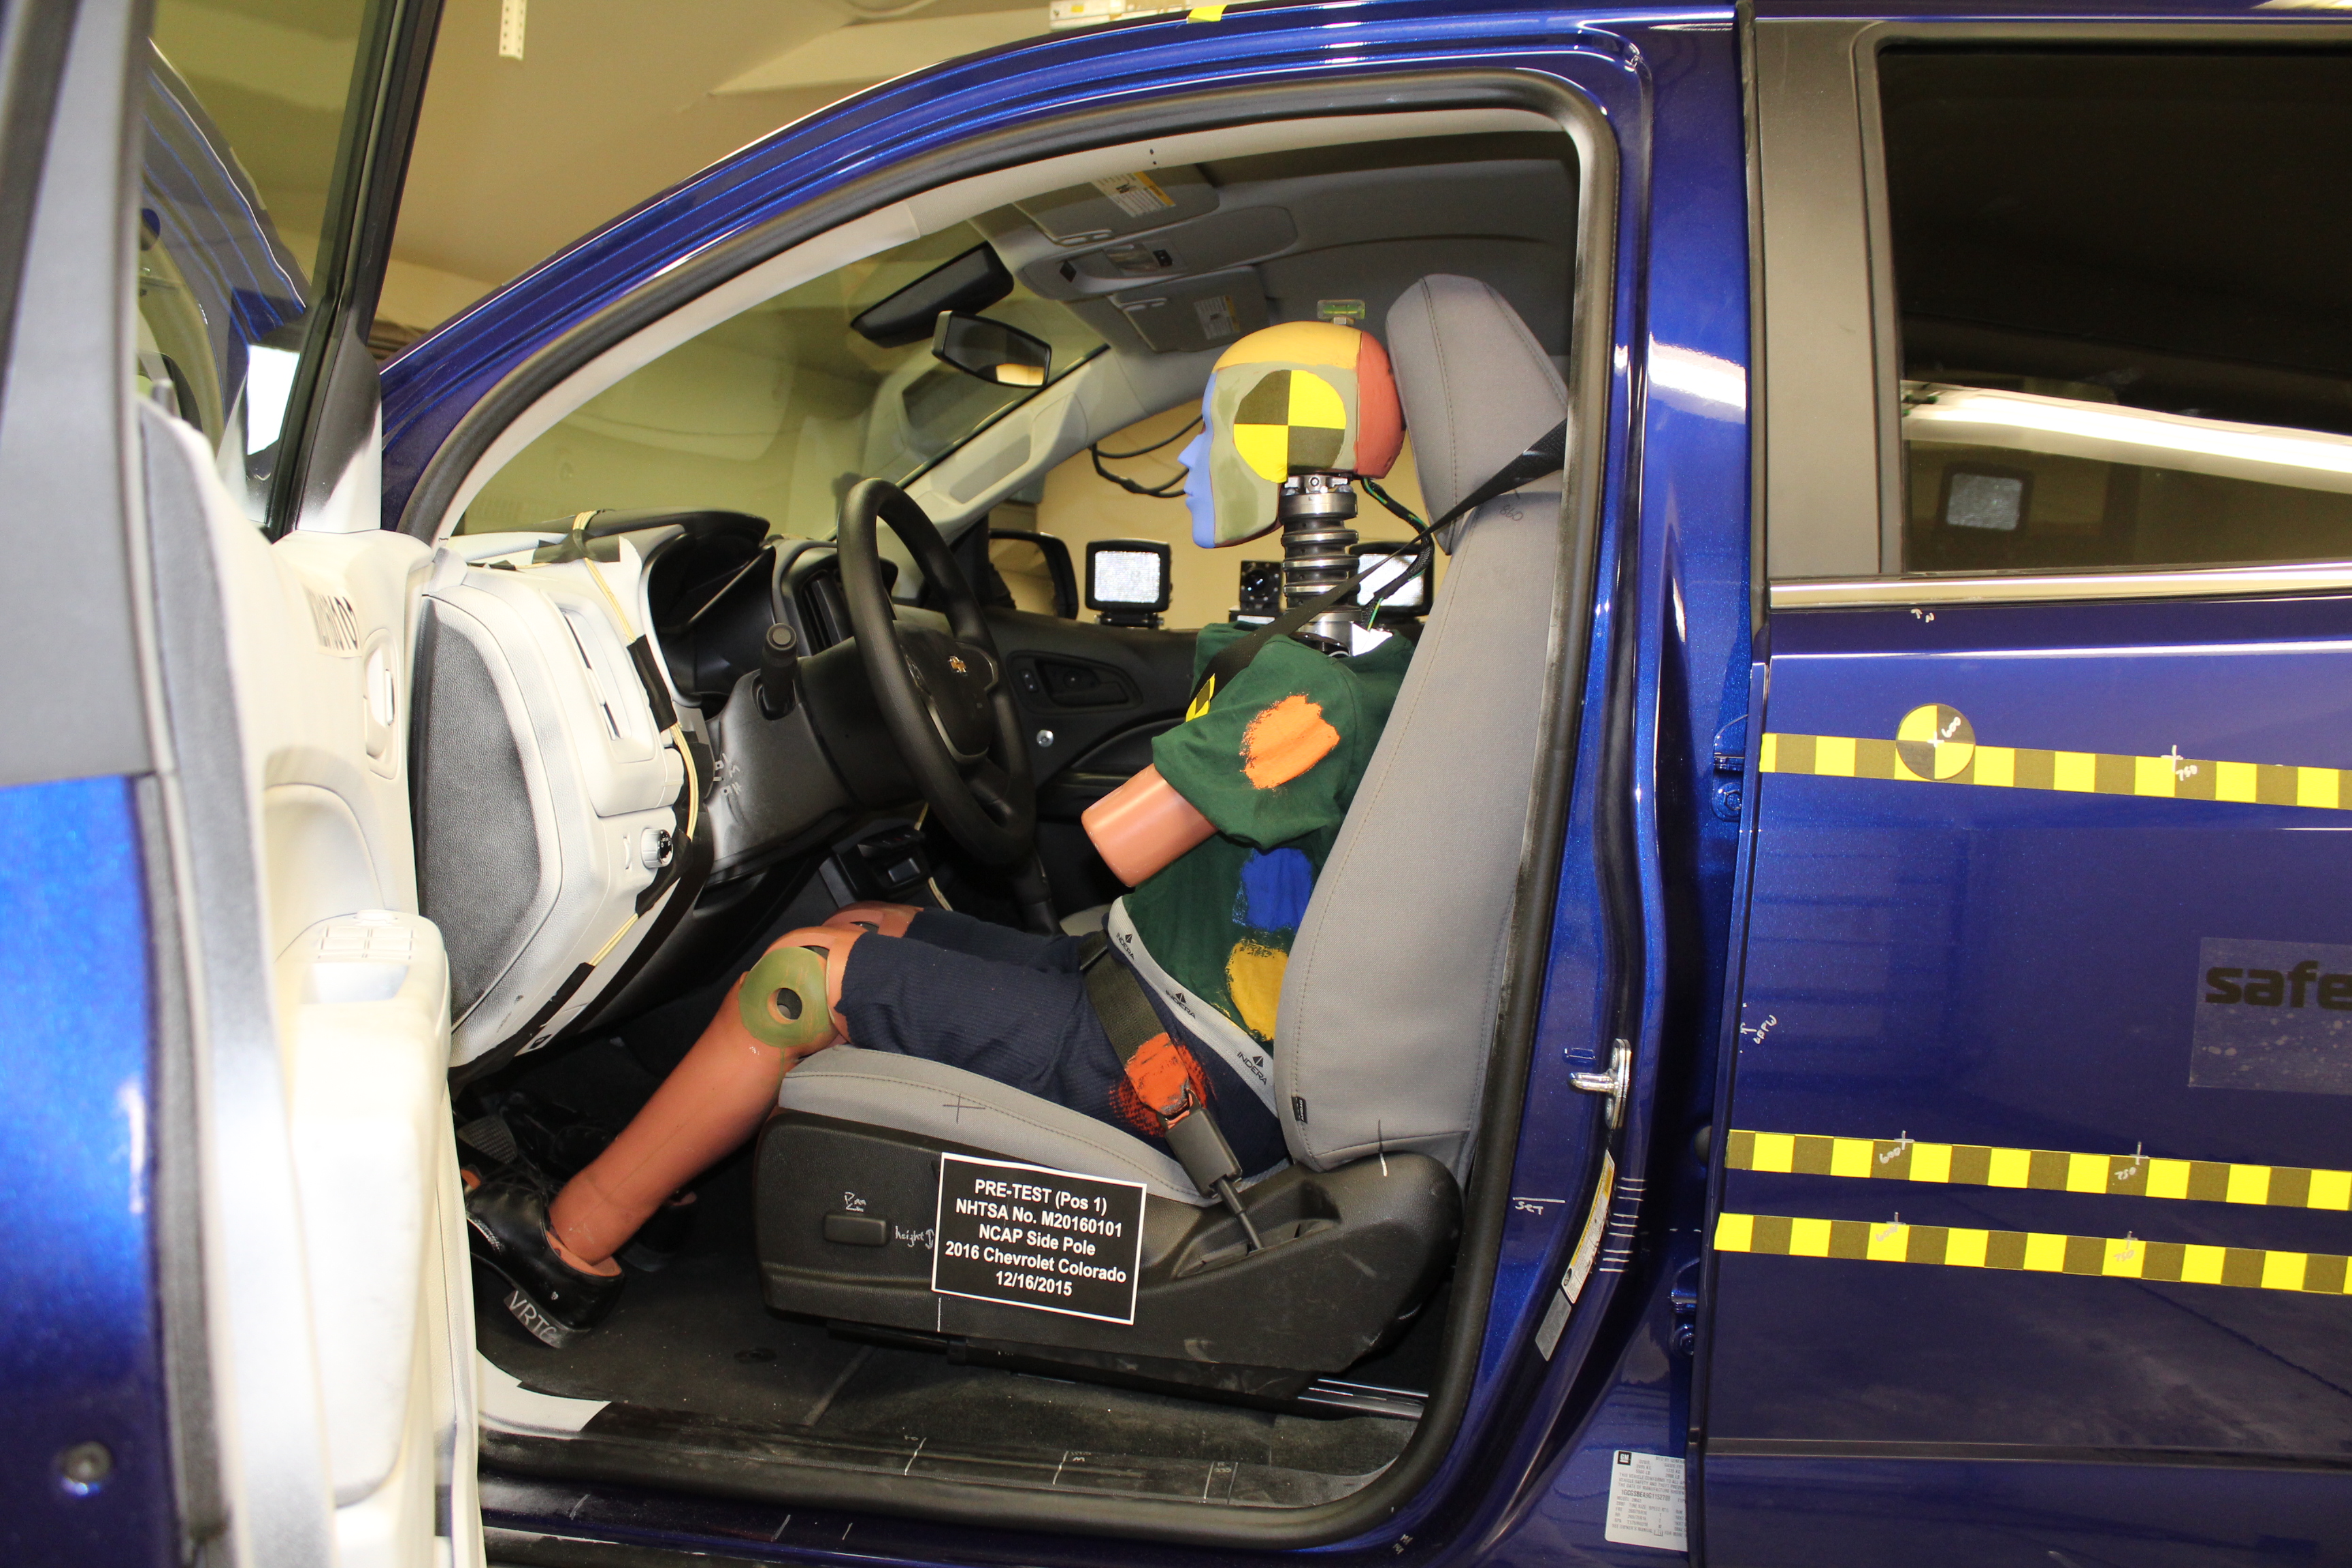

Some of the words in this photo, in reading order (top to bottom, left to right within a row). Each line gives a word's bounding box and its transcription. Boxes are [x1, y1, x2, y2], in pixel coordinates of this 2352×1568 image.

[1941, 717, 1961, 738] 600
[1116, 932, 1135, 960] INDERA
[2206, 960, 2352, 1011] safe
[1165, 990, 1196, 1019] INDERA
[1237, 1051, 1268, 1085] INDERA
[1879, 1147, 1901, 1164] 600
[975, 1179, 1052, 1204] PRE-TEST
[1055, 1190, 1089, 1210] (Pos
[1093, 1196, 1107, 1217] 1)
[956, 1198, 1009, 1220] NHTSA
[1012, 1207, 1037, 1225] No.
[1041, 1210, 1122, 1238] M20160101
[979, 1224, 1023, 1244] NCAP
[1026, 1231, 1059, 1250] Side
[1063, 1237, 1096, 1256] Pole
[945, 1241, 979, 1260] 2016
[983, 1247, 1055, 1272] Chevrolet
[1058, 1258, 1127, 1284] Colorado
[995, 1271, 1073, 1297] 12/16/2015
